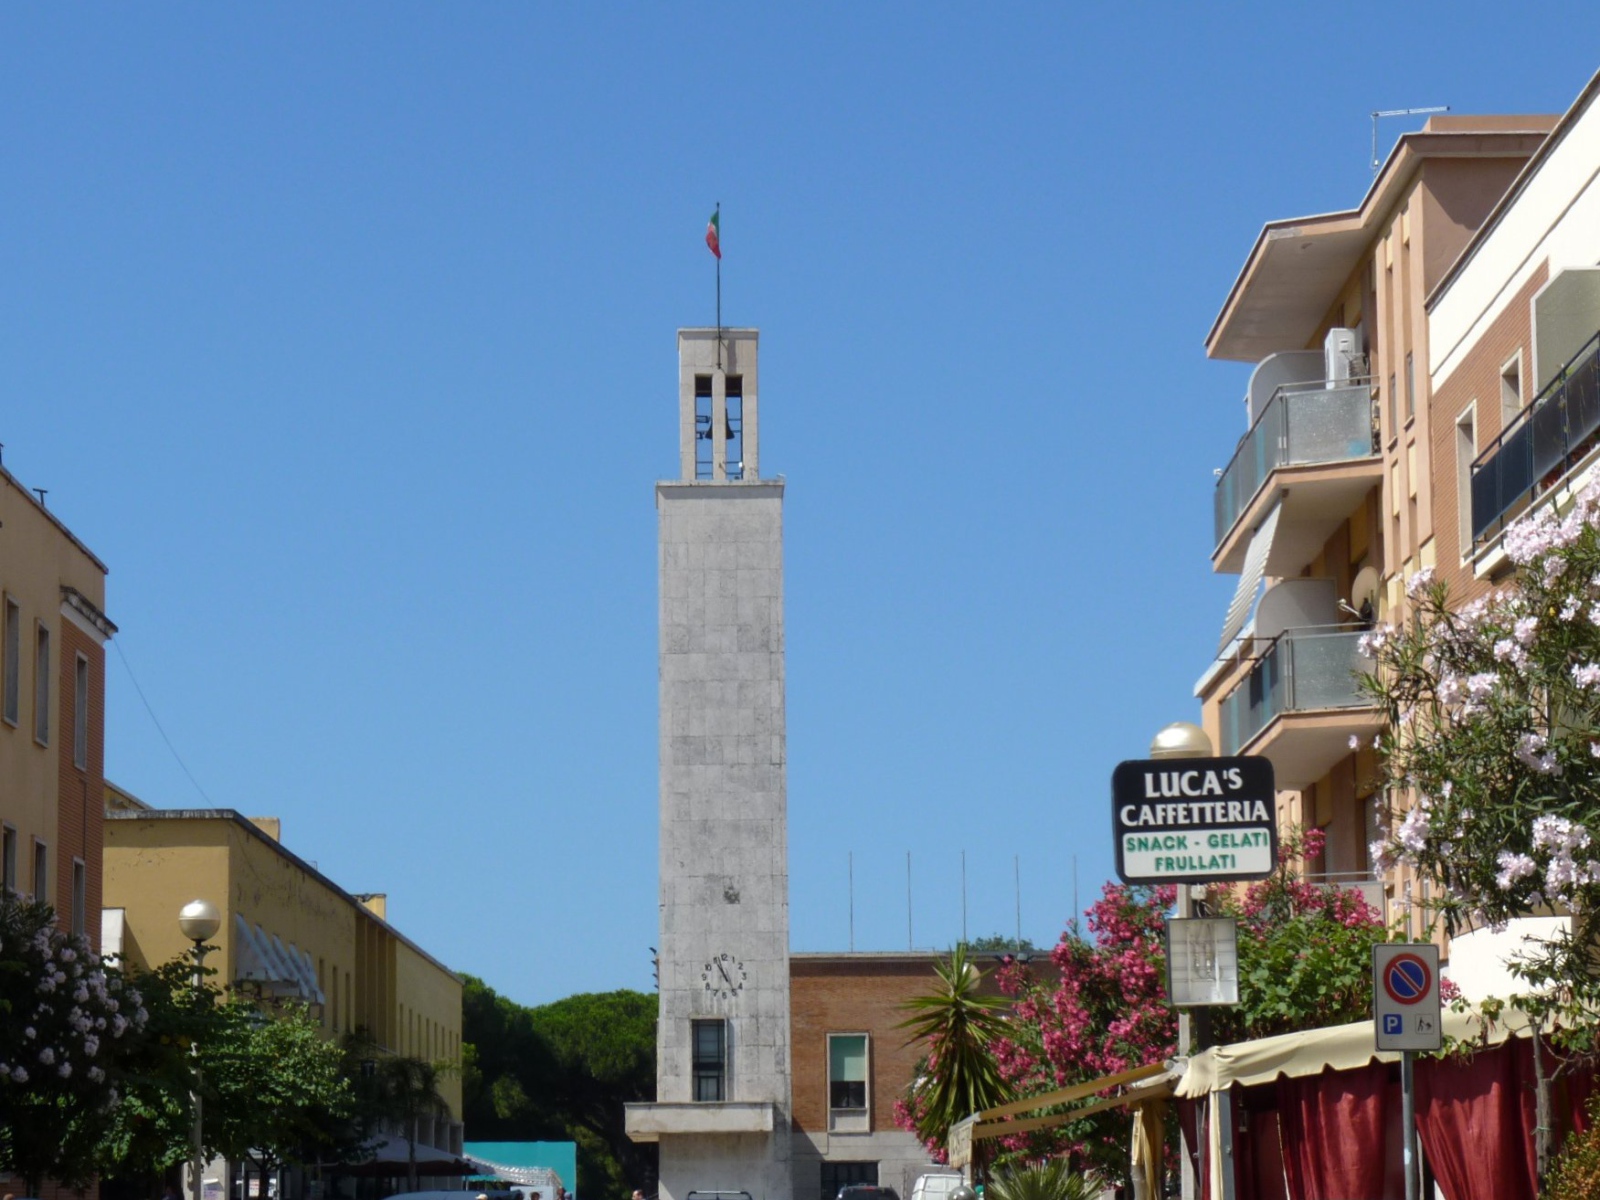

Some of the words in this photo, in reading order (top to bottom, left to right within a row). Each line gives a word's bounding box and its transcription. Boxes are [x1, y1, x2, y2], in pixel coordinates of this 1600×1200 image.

[1144, 767, 1243, 798] LUCA'S
[1120, 800, 1270, 827] CAFFETTERIA
[1126, 835, 1188, 852] SNACK
[1207, 832, 1269, 849] GELATI
[1155, 854, 1236, 872] FRULLATI
[720, 953, 728, 961] 12
[738, 962, 743, 970] 2
[741, 972, 747, 980] 3
[713, 989, 719, 997] 7
[1387, 1016, 1398, 1032] P
